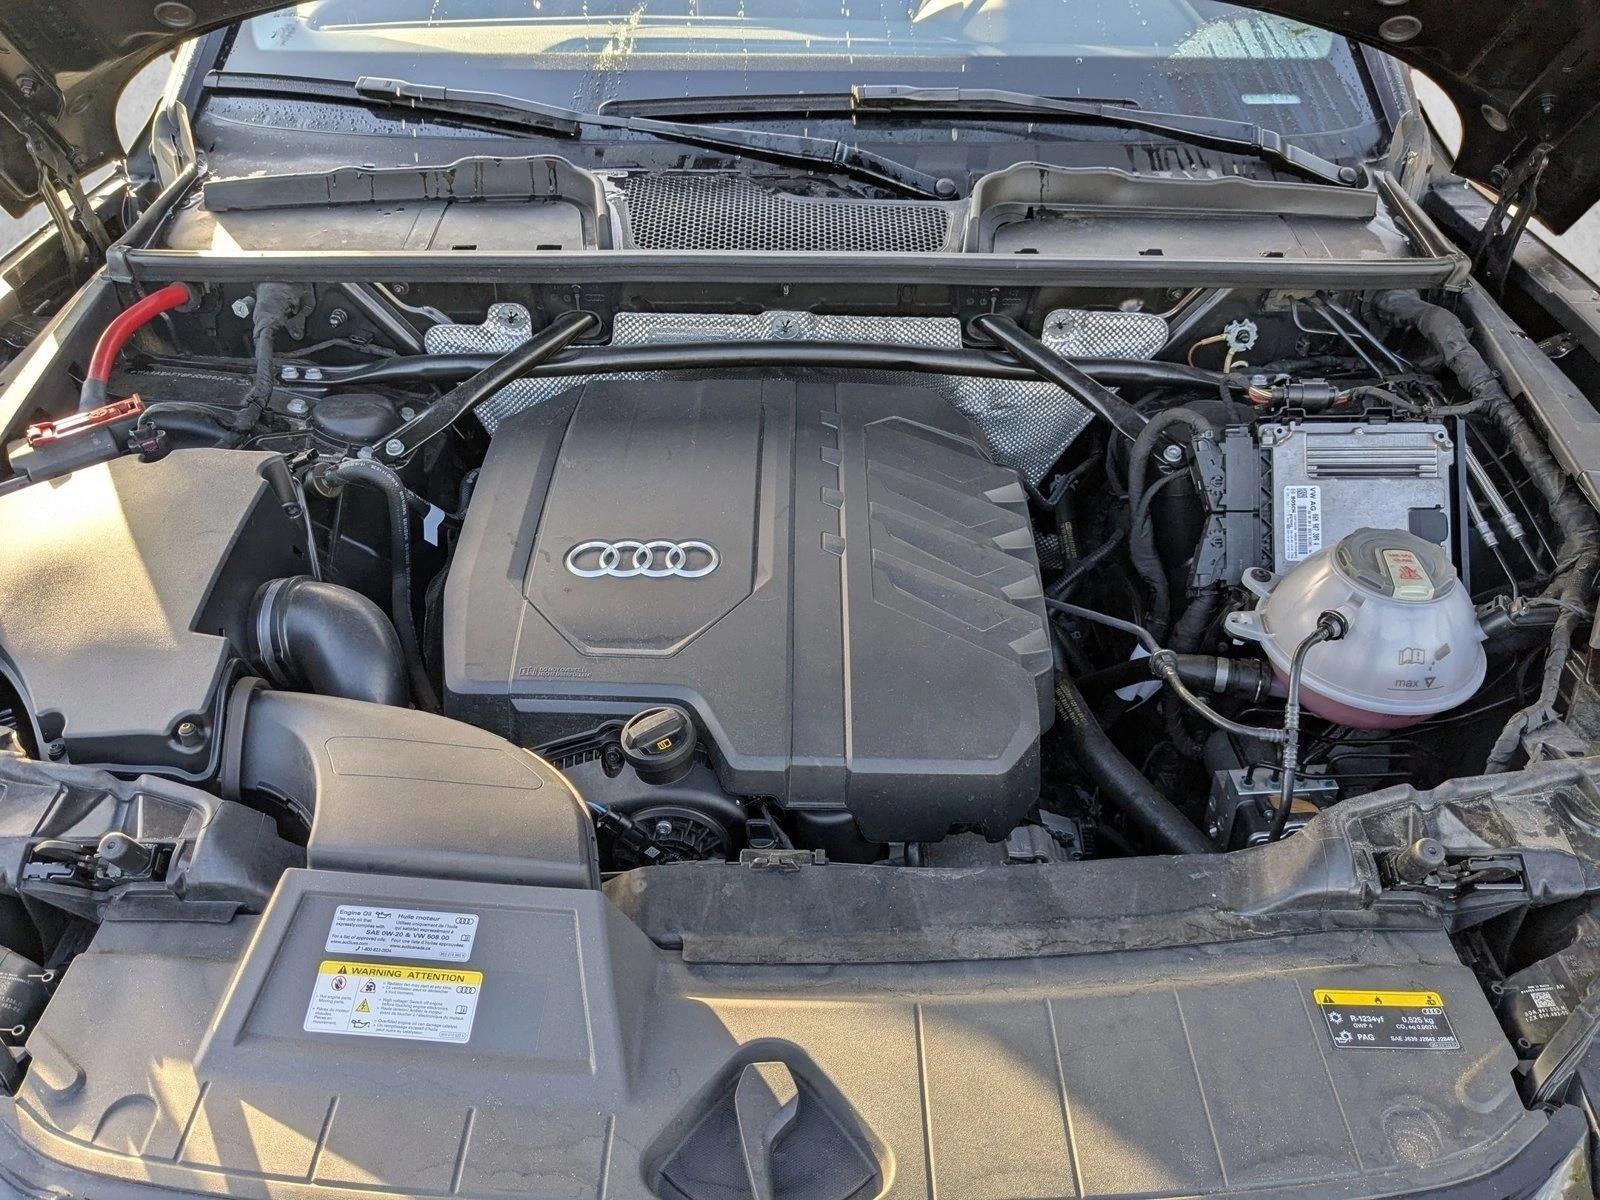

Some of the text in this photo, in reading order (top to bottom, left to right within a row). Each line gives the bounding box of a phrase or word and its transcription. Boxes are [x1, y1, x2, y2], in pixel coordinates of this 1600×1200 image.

[1310, 487, 1316, 499] VW
[1310, 501, 1316, 511] AG
[352, 968, 465, 982] WARNING ATTENTION
[1350, 1015, 1385, 1023] R-1234yf
[1423, 1017, 1435, 1025] kg
